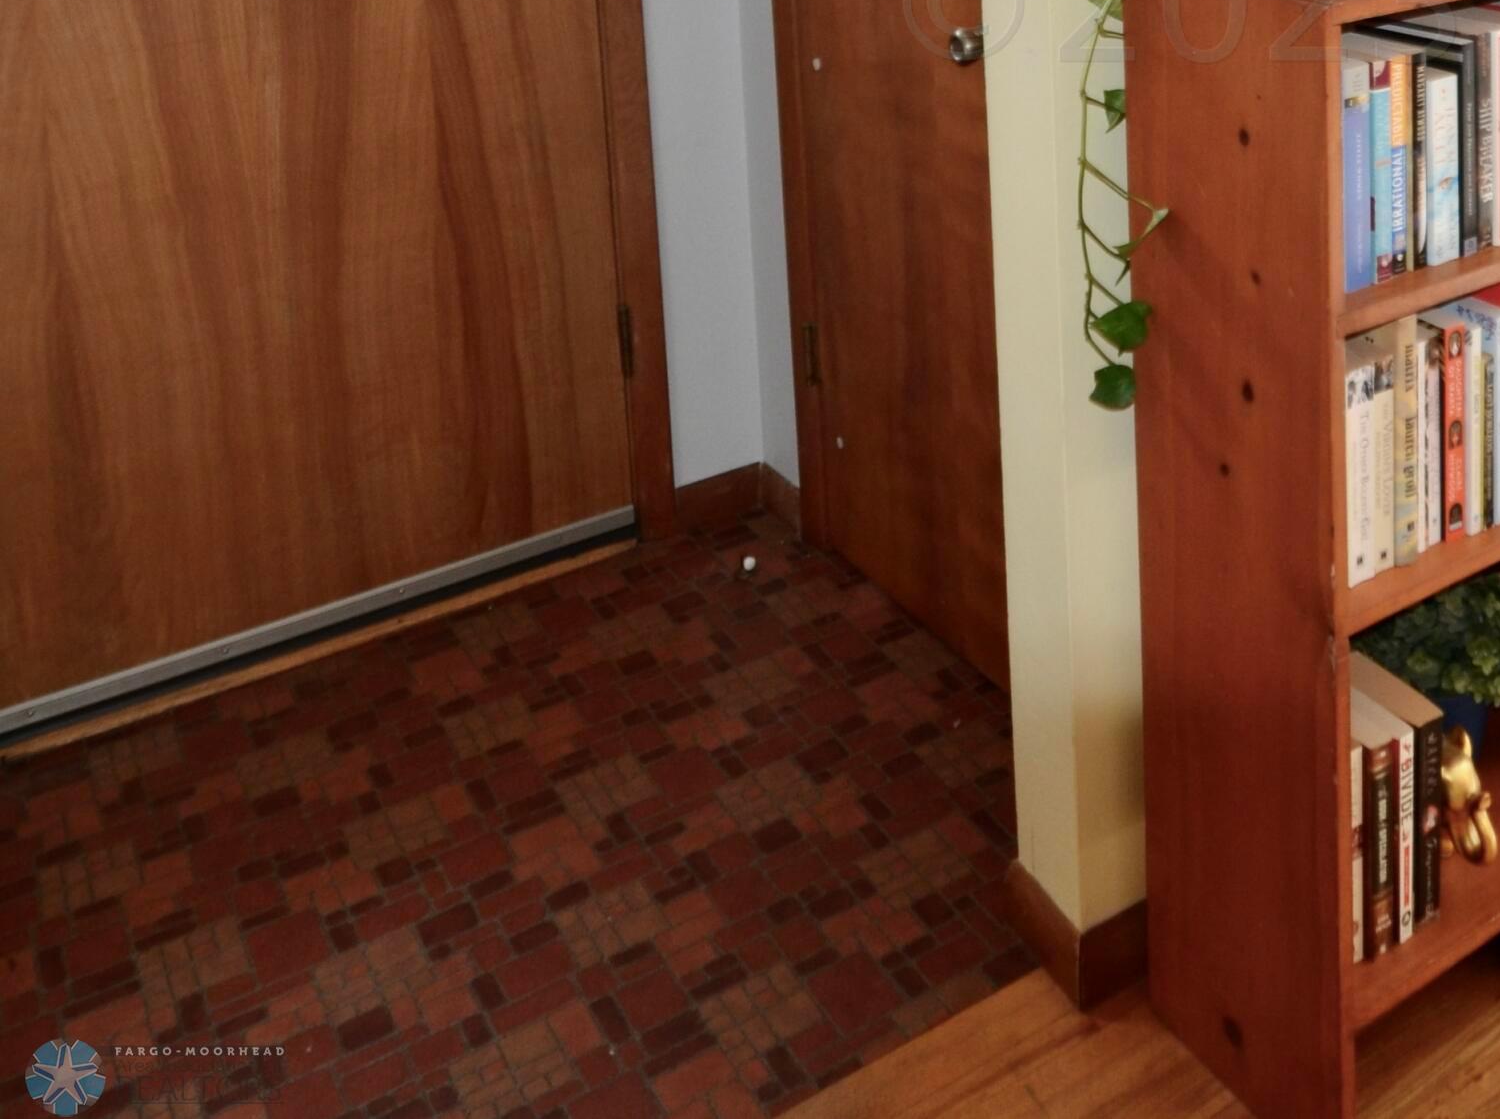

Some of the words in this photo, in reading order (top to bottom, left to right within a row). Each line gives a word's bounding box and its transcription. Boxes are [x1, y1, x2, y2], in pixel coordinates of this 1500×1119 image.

[1392, 153, 1405, 232] IRRATIONAL
[1479, 136, 1493, 203] BREAKER
[1404, 416, 1416, 462] lauren
